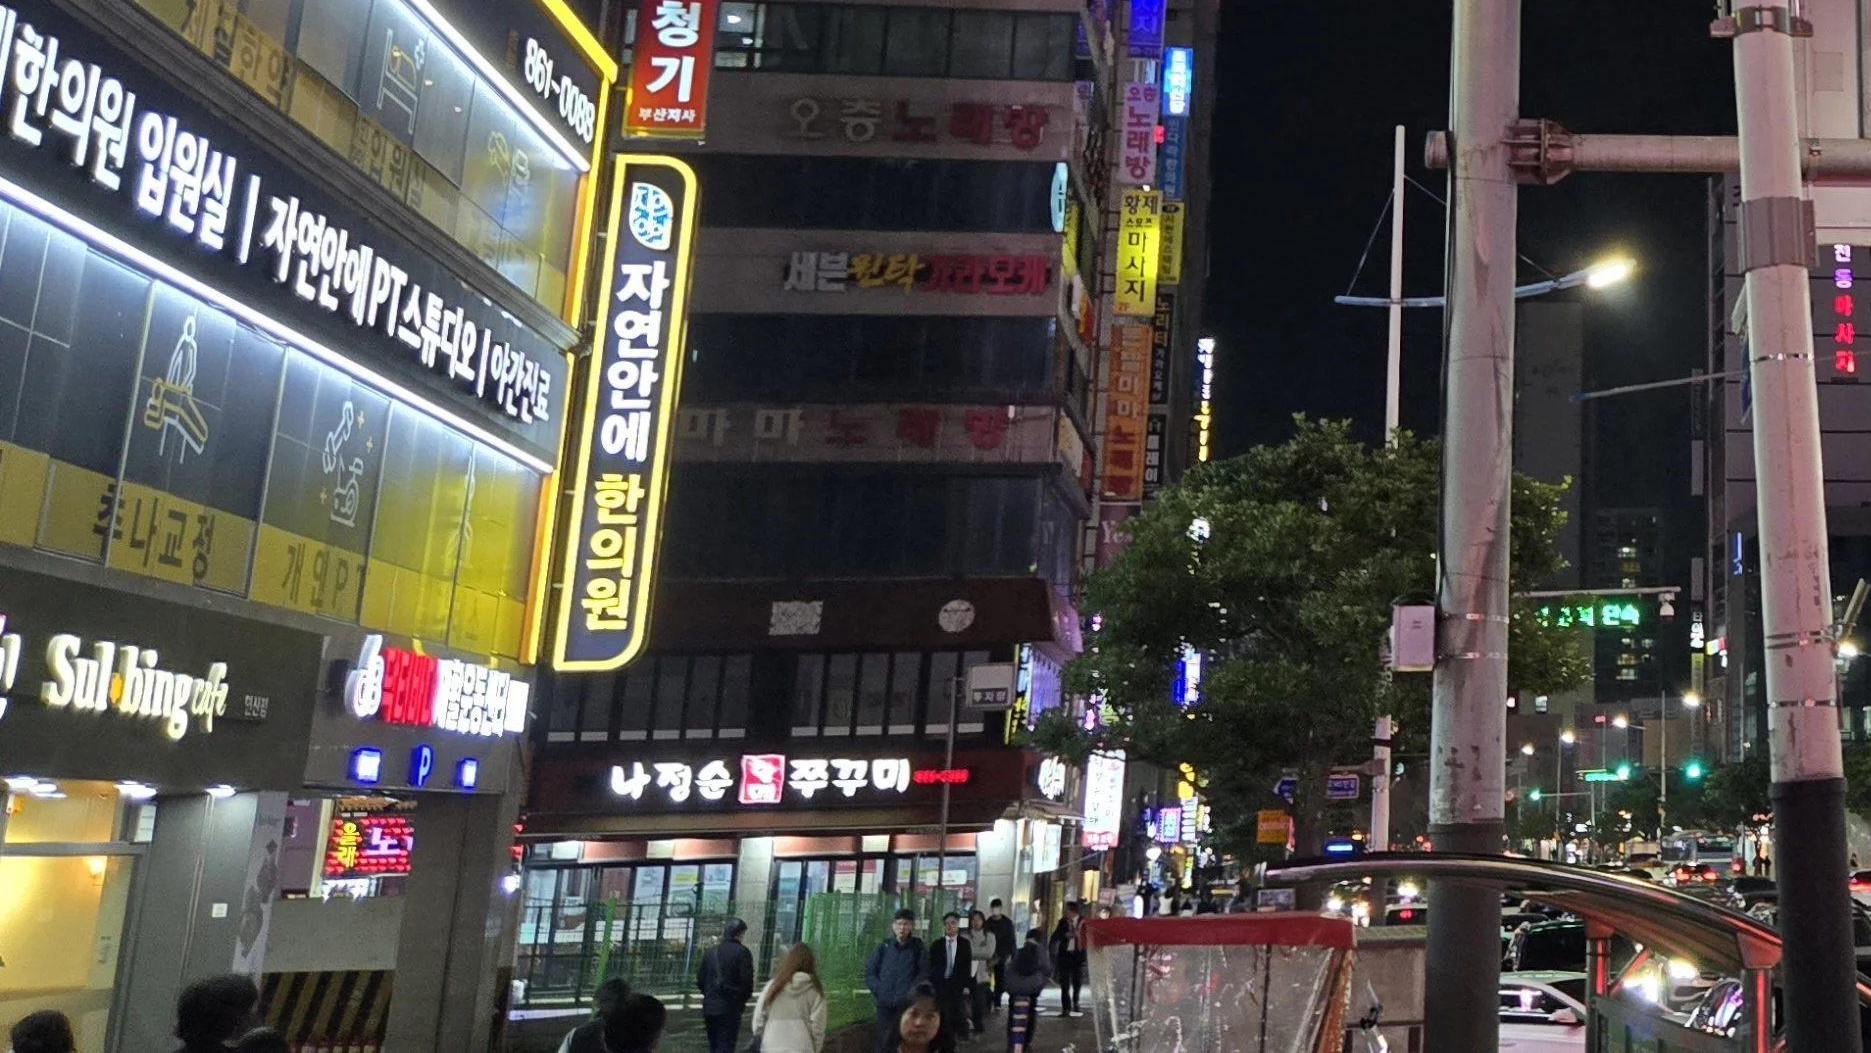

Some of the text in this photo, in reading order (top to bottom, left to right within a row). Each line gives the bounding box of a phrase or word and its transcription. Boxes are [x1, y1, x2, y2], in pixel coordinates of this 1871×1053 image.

[524, 38, 596, 144] 861-0088
[638, 107, 697, 123] 부산지사
[1124, 107, 1153, 179] 노래방
[1124, 194, 1158, 217] 황제
[137, 109, 238, 251] 입원실
[264, 194, 478, 384] 자연안에PT스튜디오
[489, 342, 552, 424] 야간진료
[784, 250, 850, 294] 세븐
[1123, 231, 1150, 303] 마사지
[599, 260, 671, 464] 자연안에
[91, 478, 214, 587] 추나교정
[580, 472, 646, 632] 한의원
[280, 539, 369, 611] 개인PT
[190, 661, 231, 734] cafe
[410, 744, 434, 788] P
[609, 759, 734, 803] 나정순
[789, 757, 912, 799] 쭈꾸미
